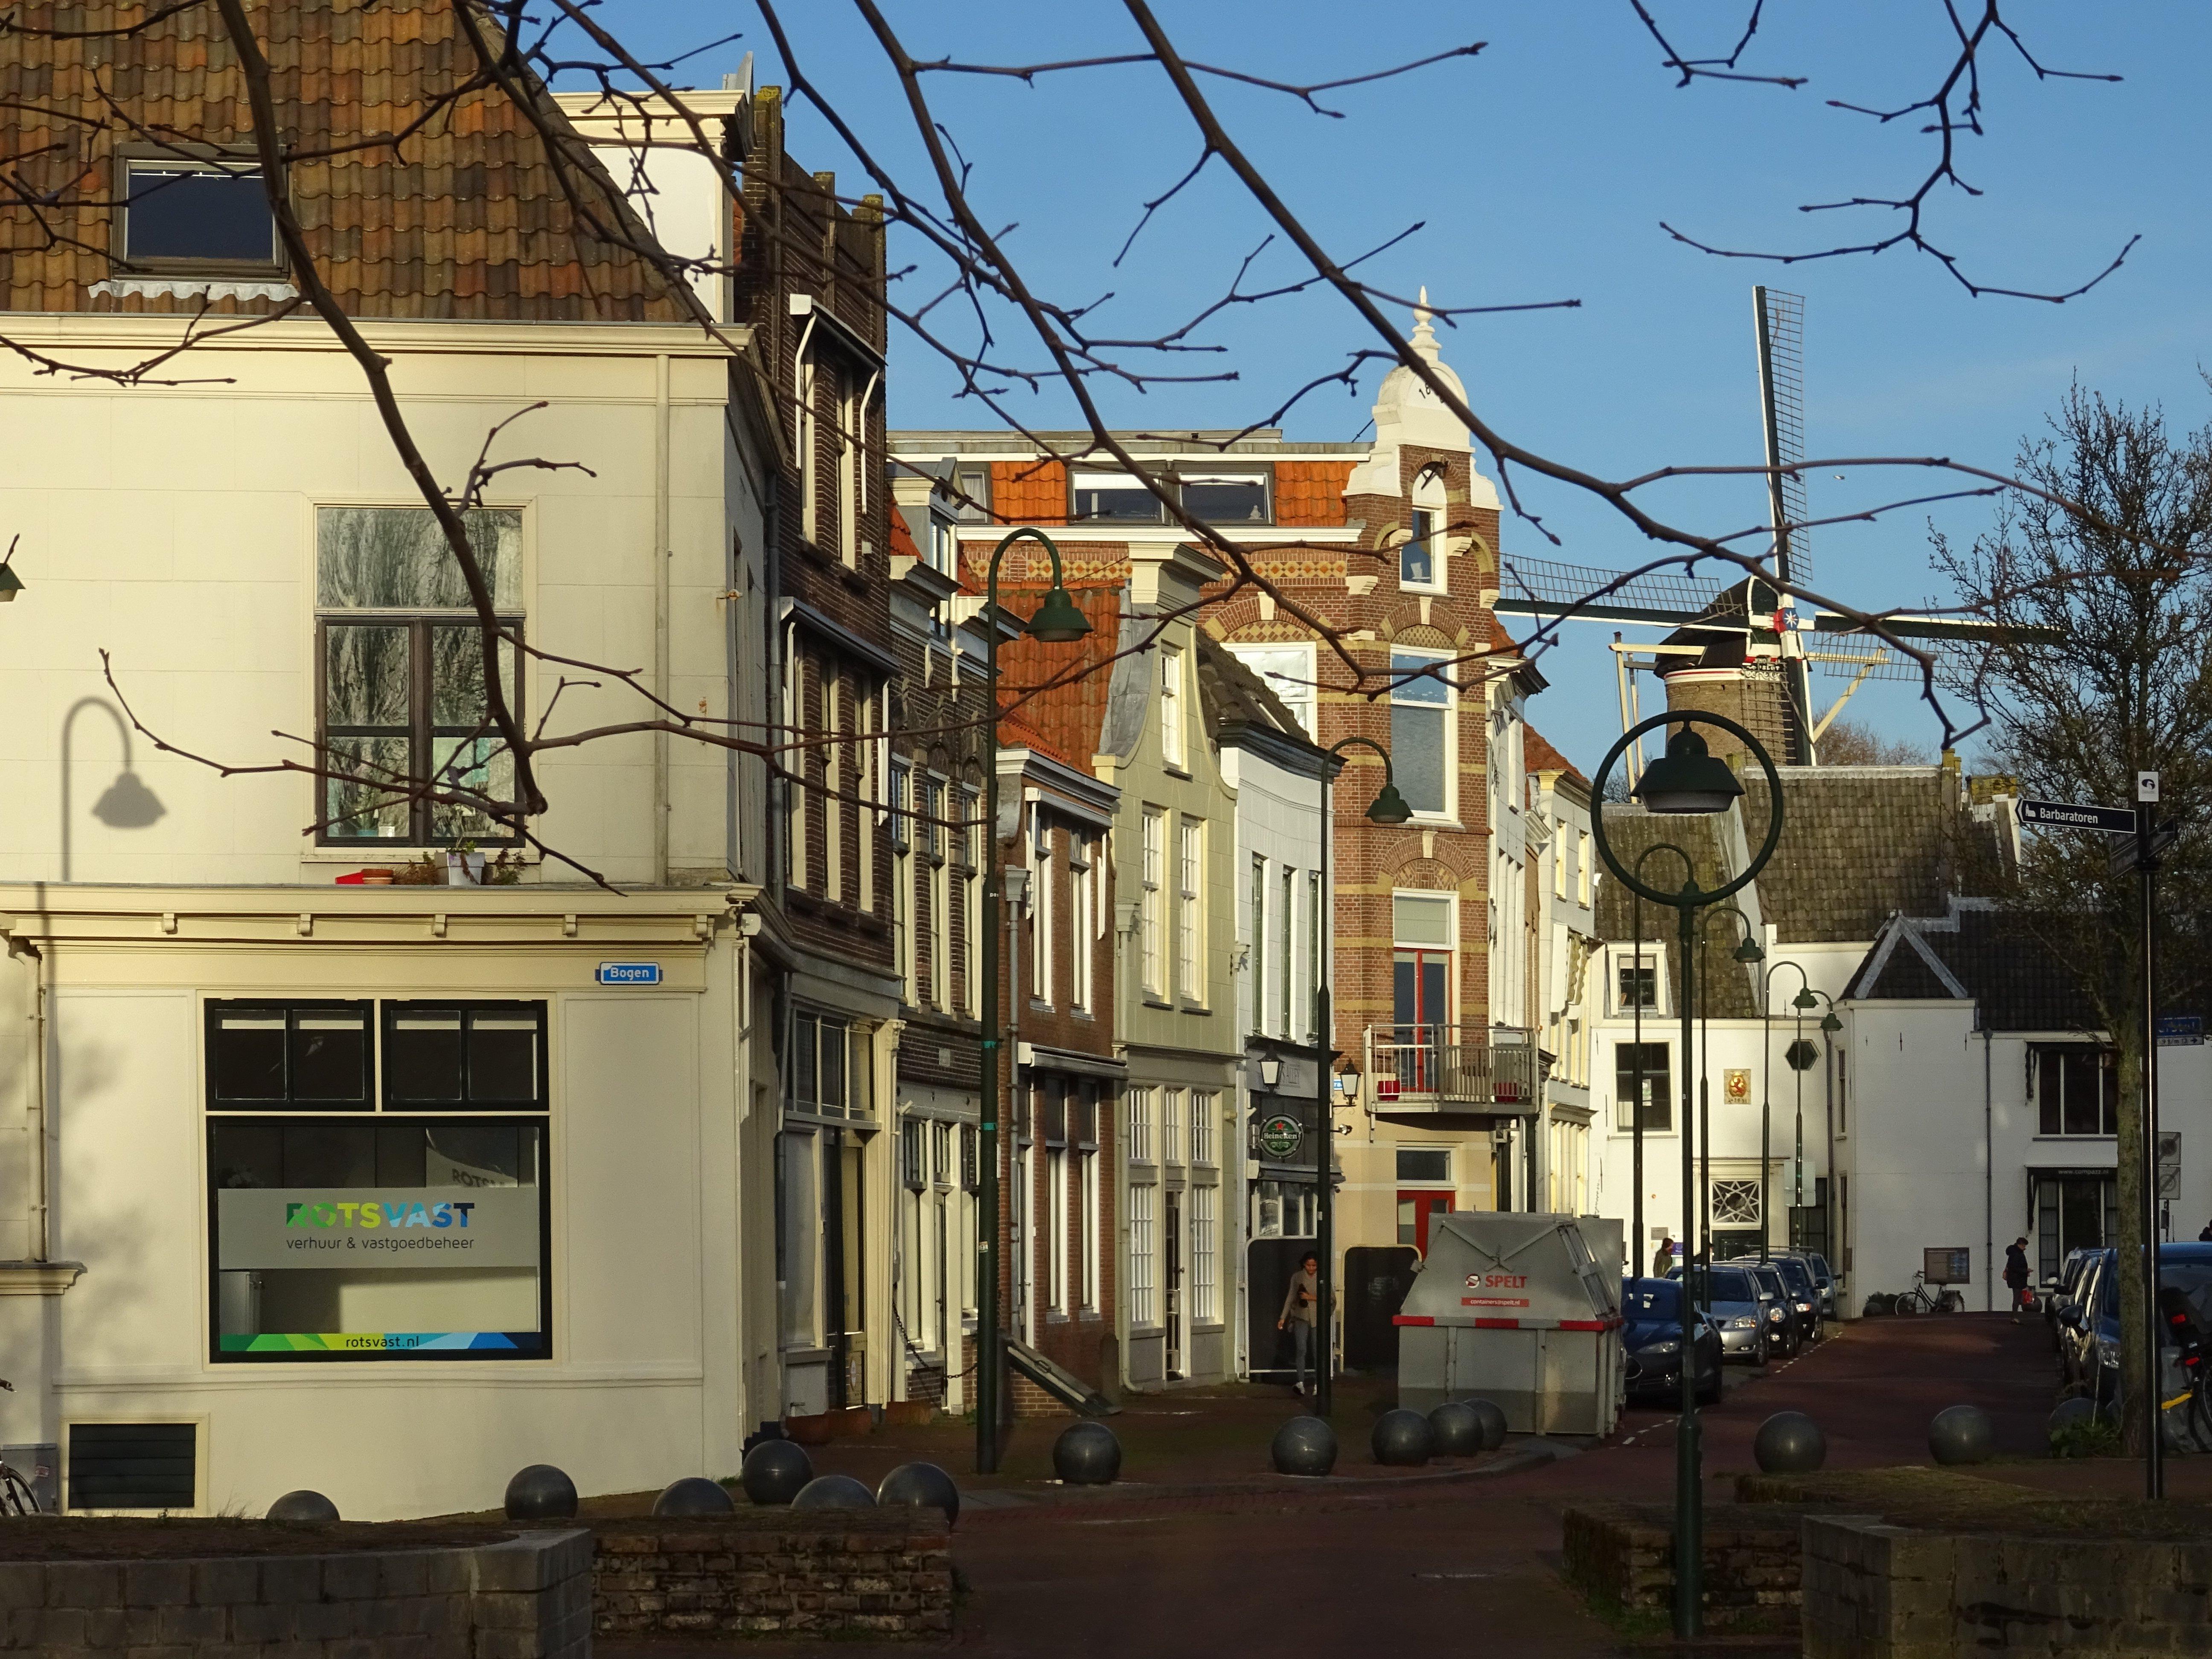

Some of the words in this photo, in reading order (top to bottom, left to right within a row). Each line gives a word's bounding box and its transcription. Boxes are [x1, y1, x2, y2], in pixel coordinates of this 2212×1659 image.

[2040, 808, 2098, 824] Barbaratoren
[610, 967, 649, 980] Bogen
[286, 1202, 475, 1228] ROTSVAST
[286, 1237, 341, 1249] verhuur
[347, 1237, 356, 1249] &
[362, 1237, 474, 1252] vastgoedbeheer
[1485, 1275, 1527, 1289] SPELT
[346, 1336, 419, 1348] rotsvast.nl
